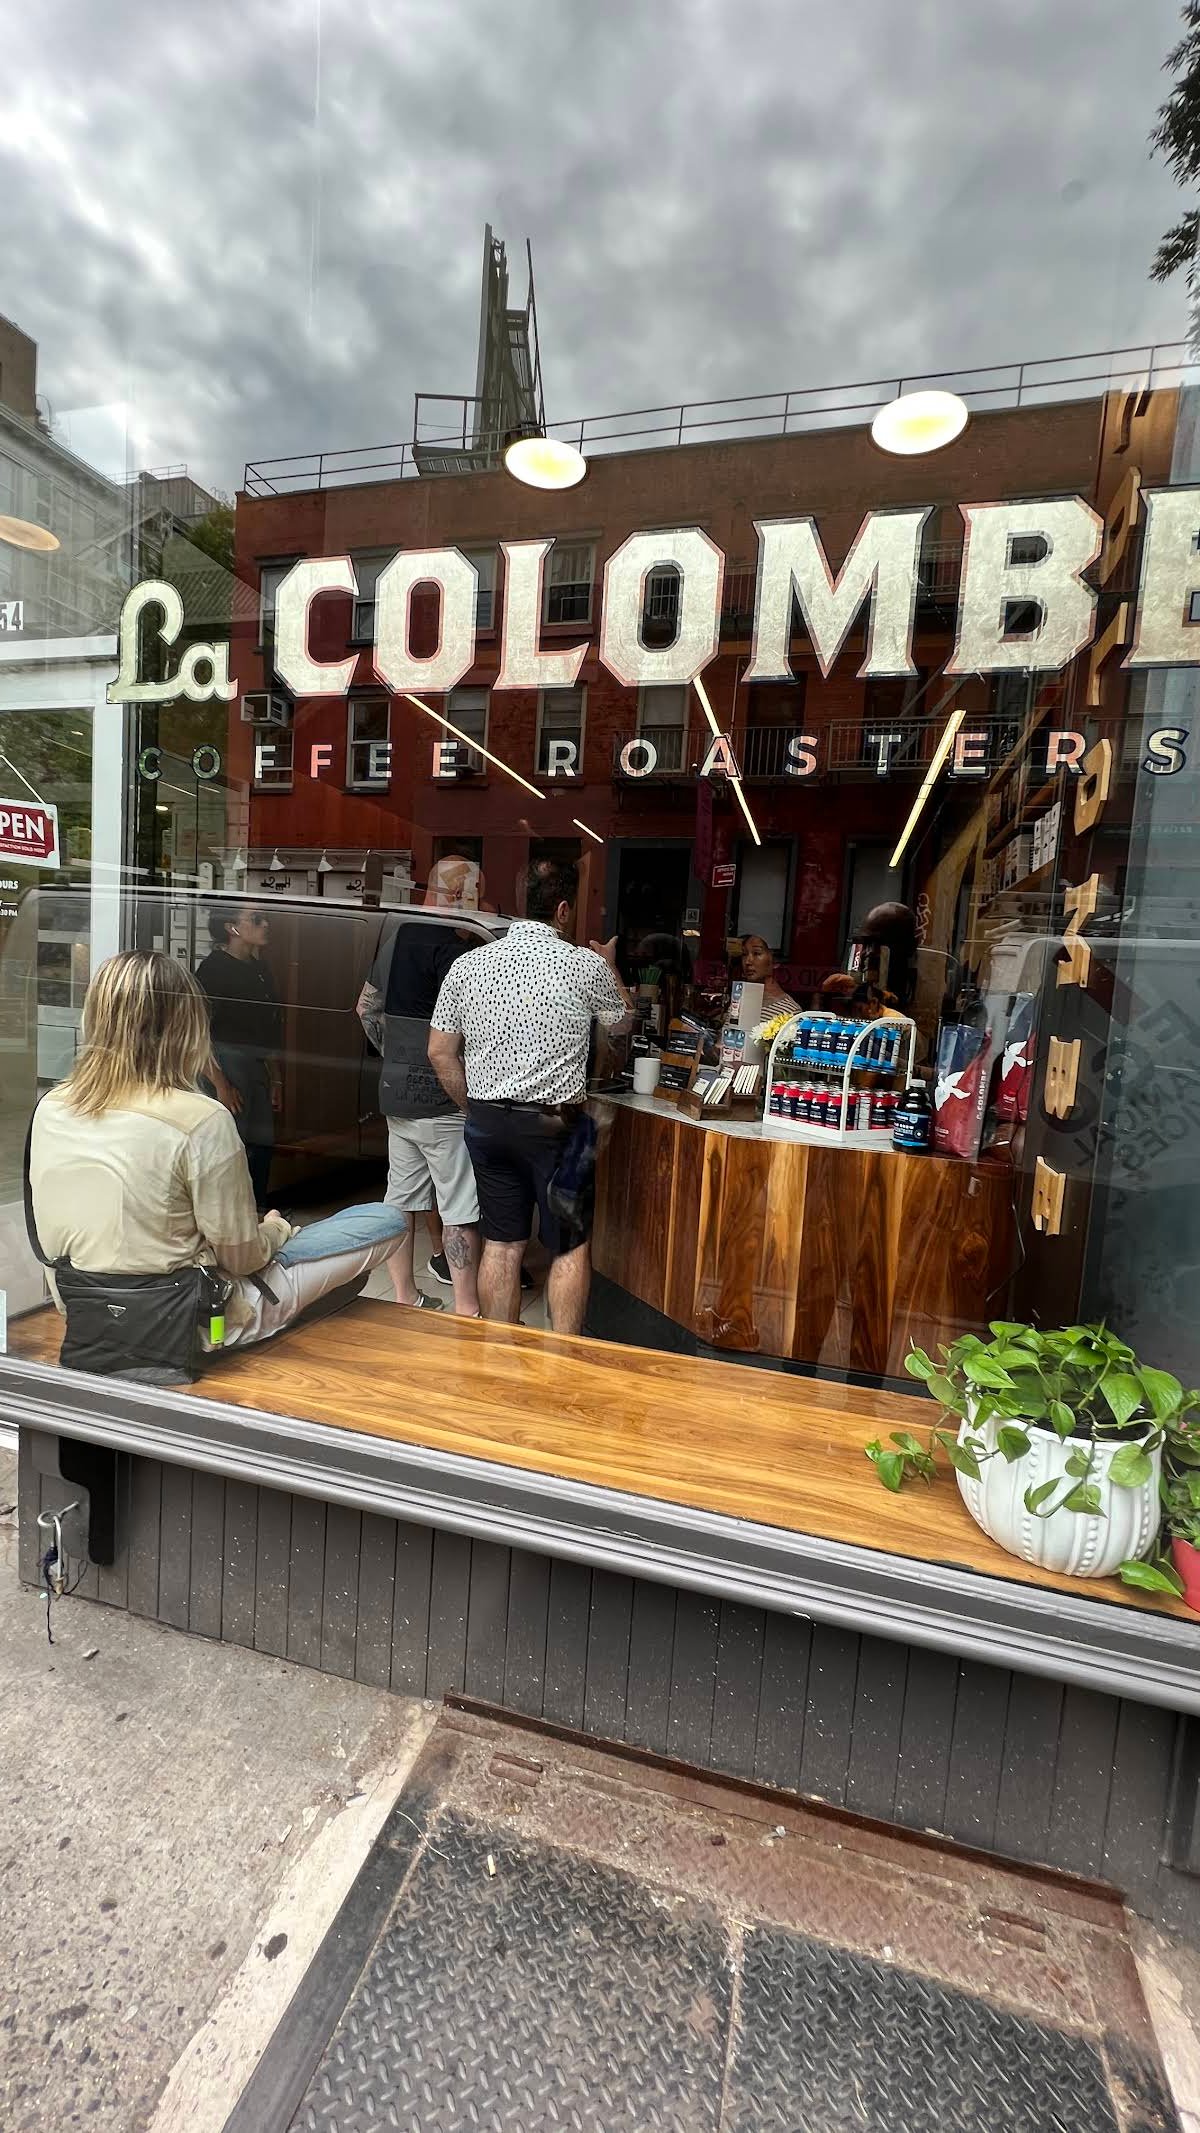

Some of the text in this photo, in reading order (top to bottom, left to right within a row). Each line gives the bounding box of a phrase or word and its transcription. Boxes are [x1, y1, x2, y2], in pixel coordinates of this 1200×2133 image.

[106, 483, 1200, 704] La COLOMBE
[138, 727, 1190, 783] COFFEE ROASTERS
